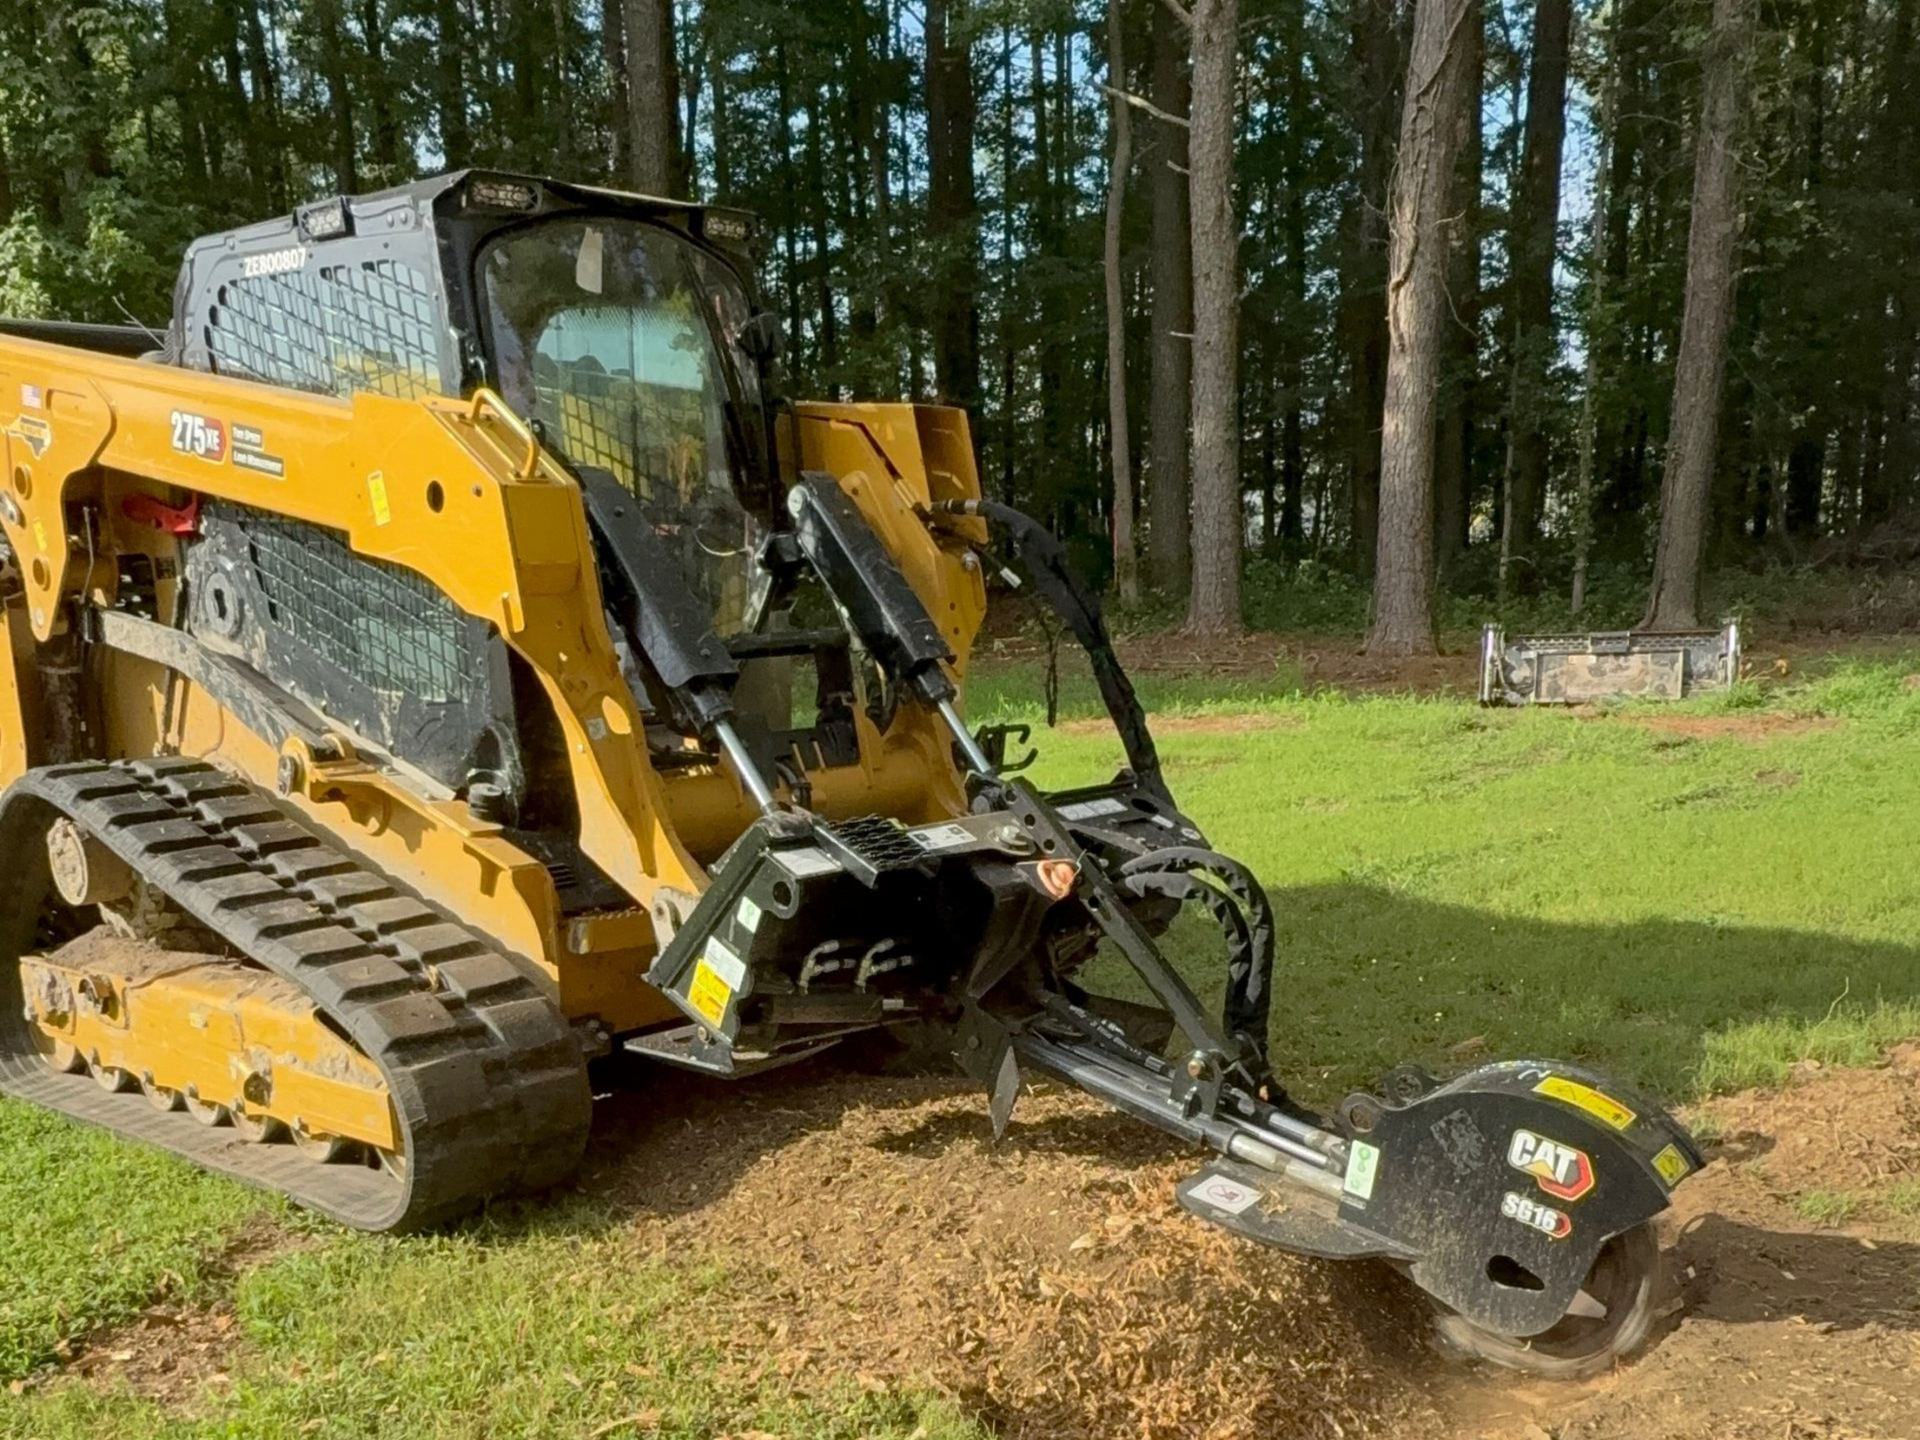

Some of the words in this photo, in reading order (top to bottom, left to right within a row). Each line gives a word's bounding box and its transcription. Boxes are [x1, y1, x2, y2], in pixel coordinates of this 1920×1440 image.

[244, 247, 306, 277] ZE800807
[1511, 1132, 1578, 1185] CAT
[1503, 1194, 1558, 1231] SG16
